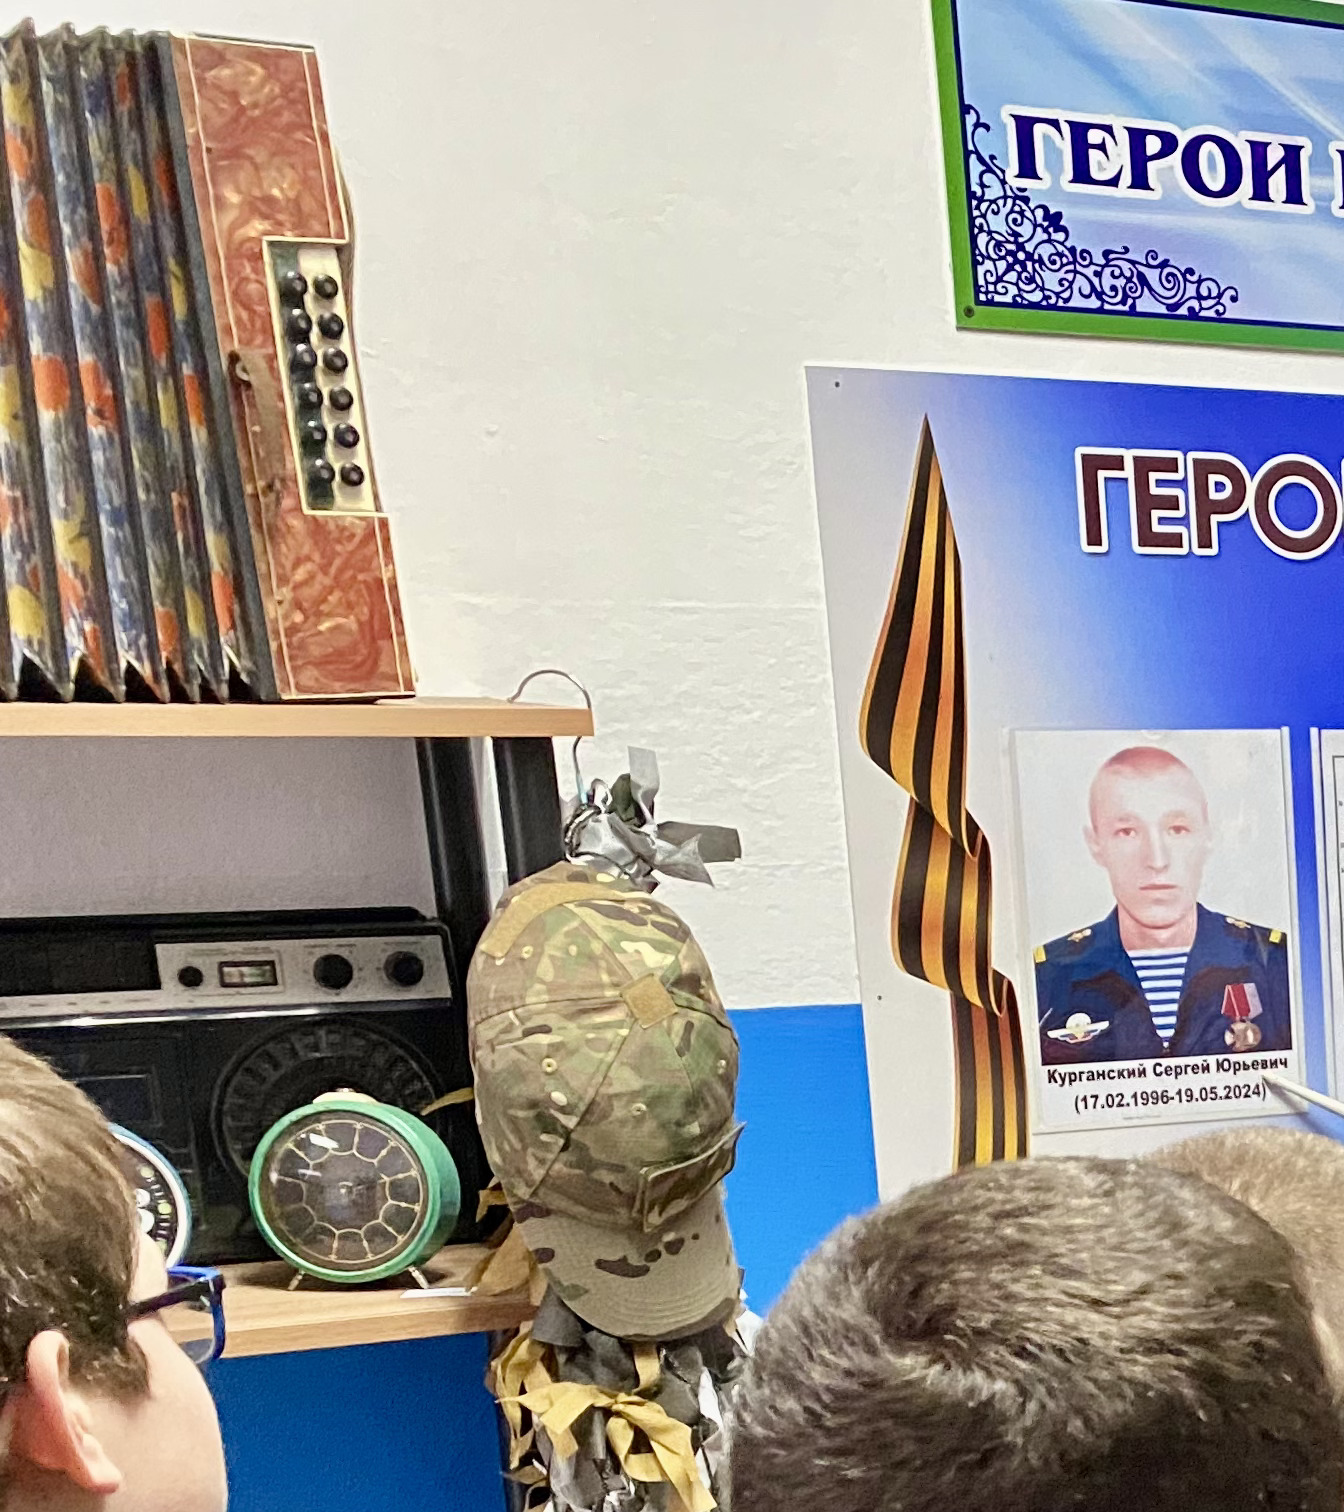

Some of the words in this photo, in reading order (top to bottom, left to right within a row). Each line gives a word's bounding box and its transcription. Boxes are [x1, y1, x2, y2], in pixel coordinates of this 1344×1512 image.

[1008, 112, 1306, 205] ГЕРОИ
[1047, 1063, 1147, 1087] Курганский
[1152, 1059, 1210, 1080] Сергей
[1216, 1055, 1289, 1076] Юрьевич
[1074, 1081, 1267, 1115] (17.02.1996-19.05.2024)
